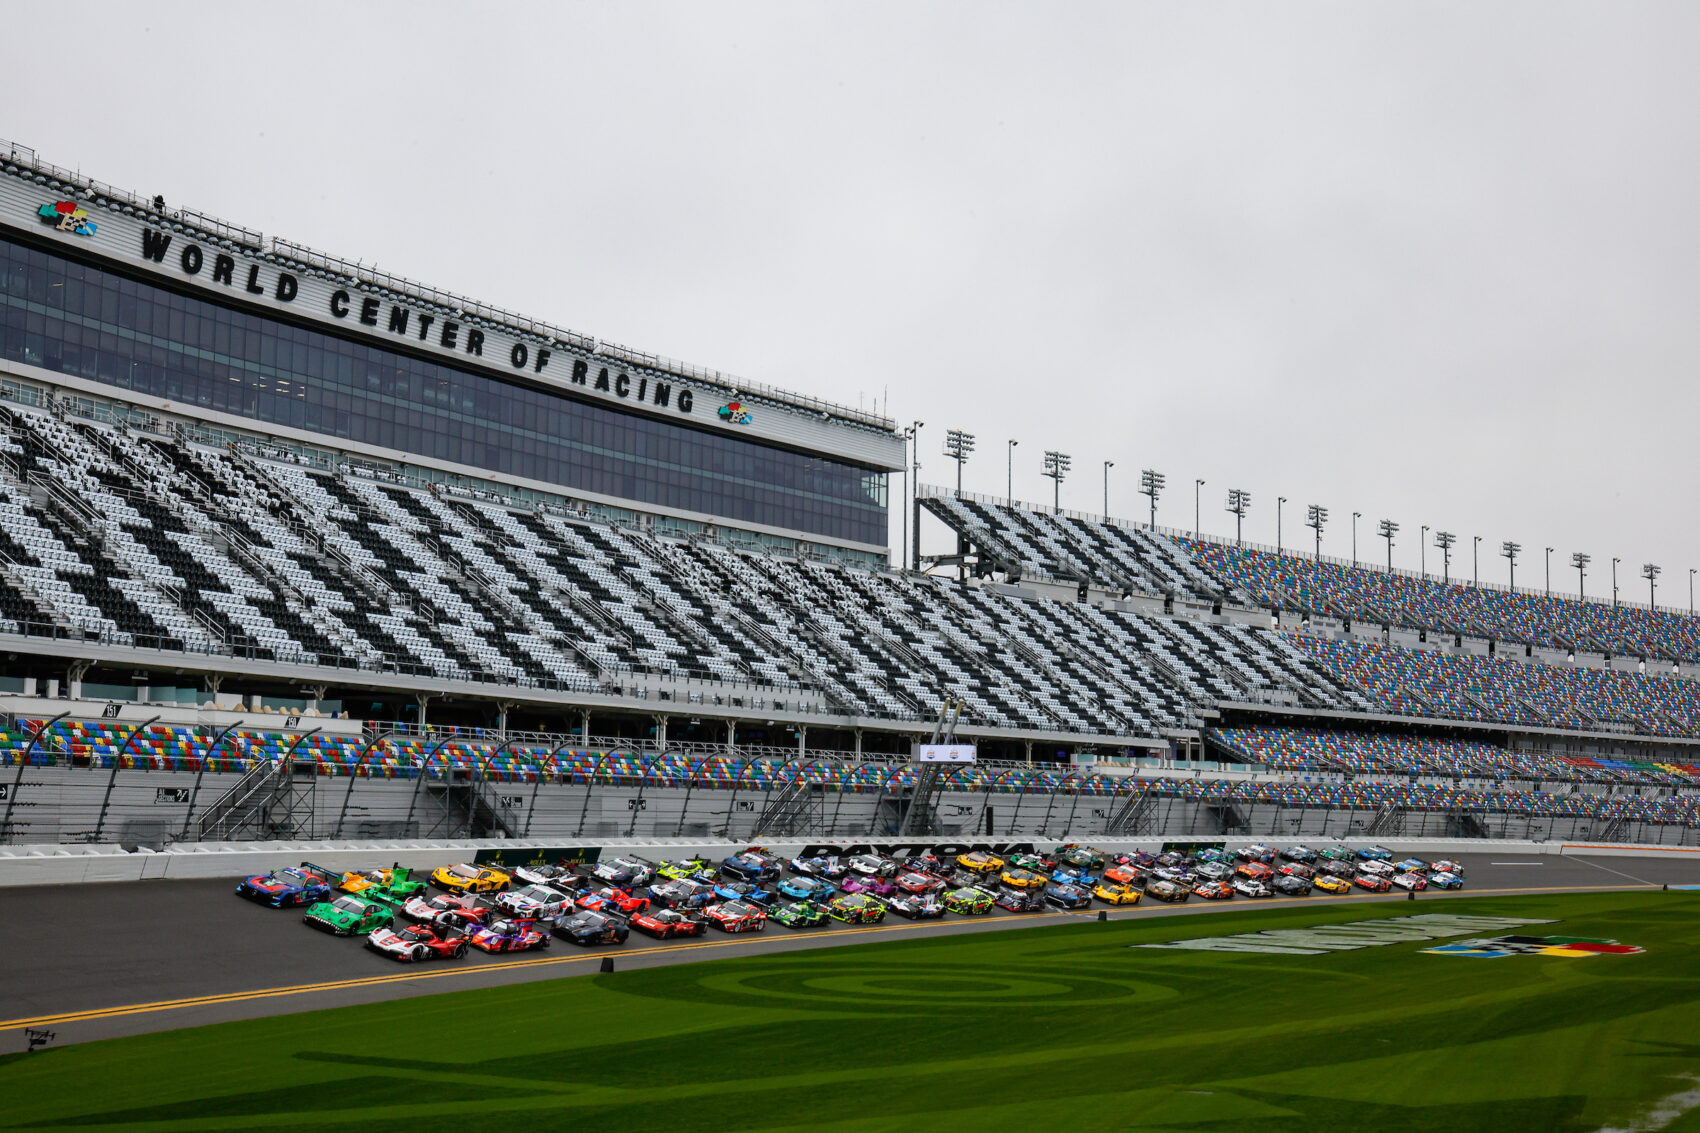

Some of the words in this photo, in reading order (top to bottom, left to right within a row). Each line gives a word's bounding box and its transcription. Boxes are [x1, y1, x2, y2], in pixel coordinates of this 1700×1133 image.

[142, 228, 298, 303] WORLD
[330, 289, 485, 356] CENTER
[511, 342, 552, 373] OF
[572, 359, 693, 413] RACING
[106, 704, 116, 717] 151
[288, 717, 297, 729] 150
[797, 843, 1035, 857] DAYTONA
